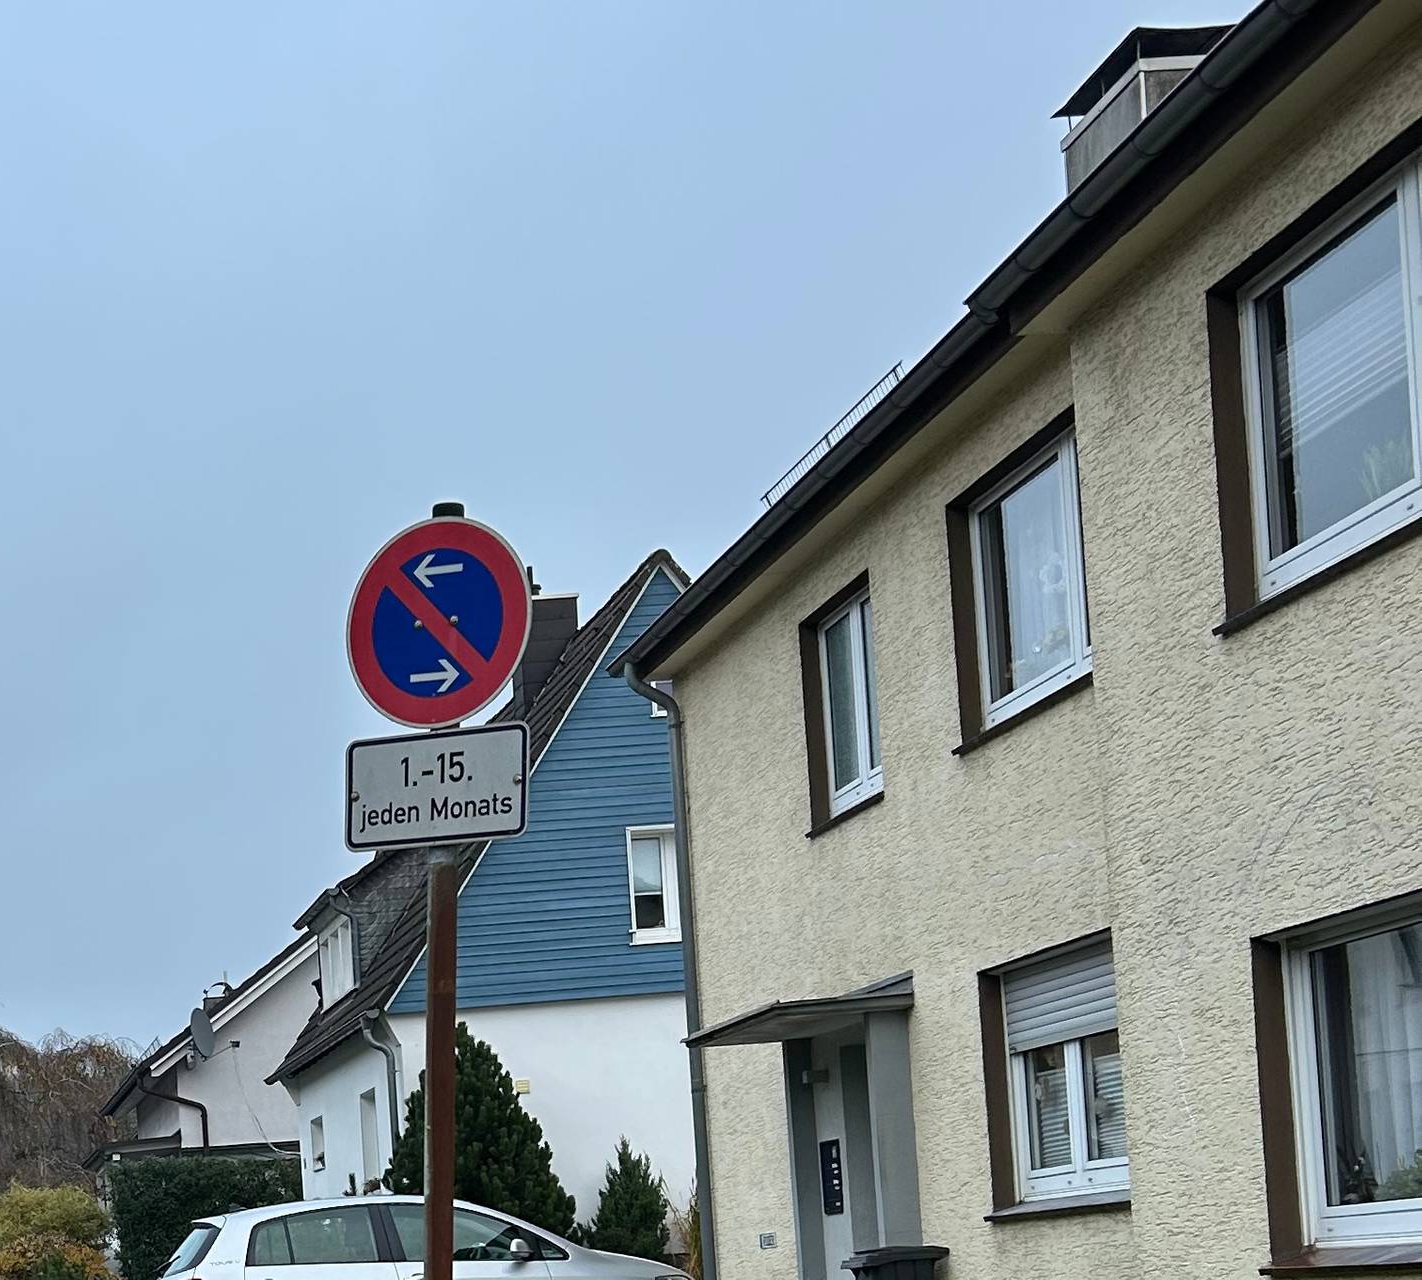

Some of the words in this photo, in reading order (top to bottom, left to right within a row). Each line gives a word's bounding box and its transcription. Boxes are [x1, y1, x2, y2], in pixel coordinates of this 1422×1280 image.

[400, 751, 473, 788] 1.-15.
[359, 802, 420, 833] jeden
[430, 793, 513, 821] Monats
